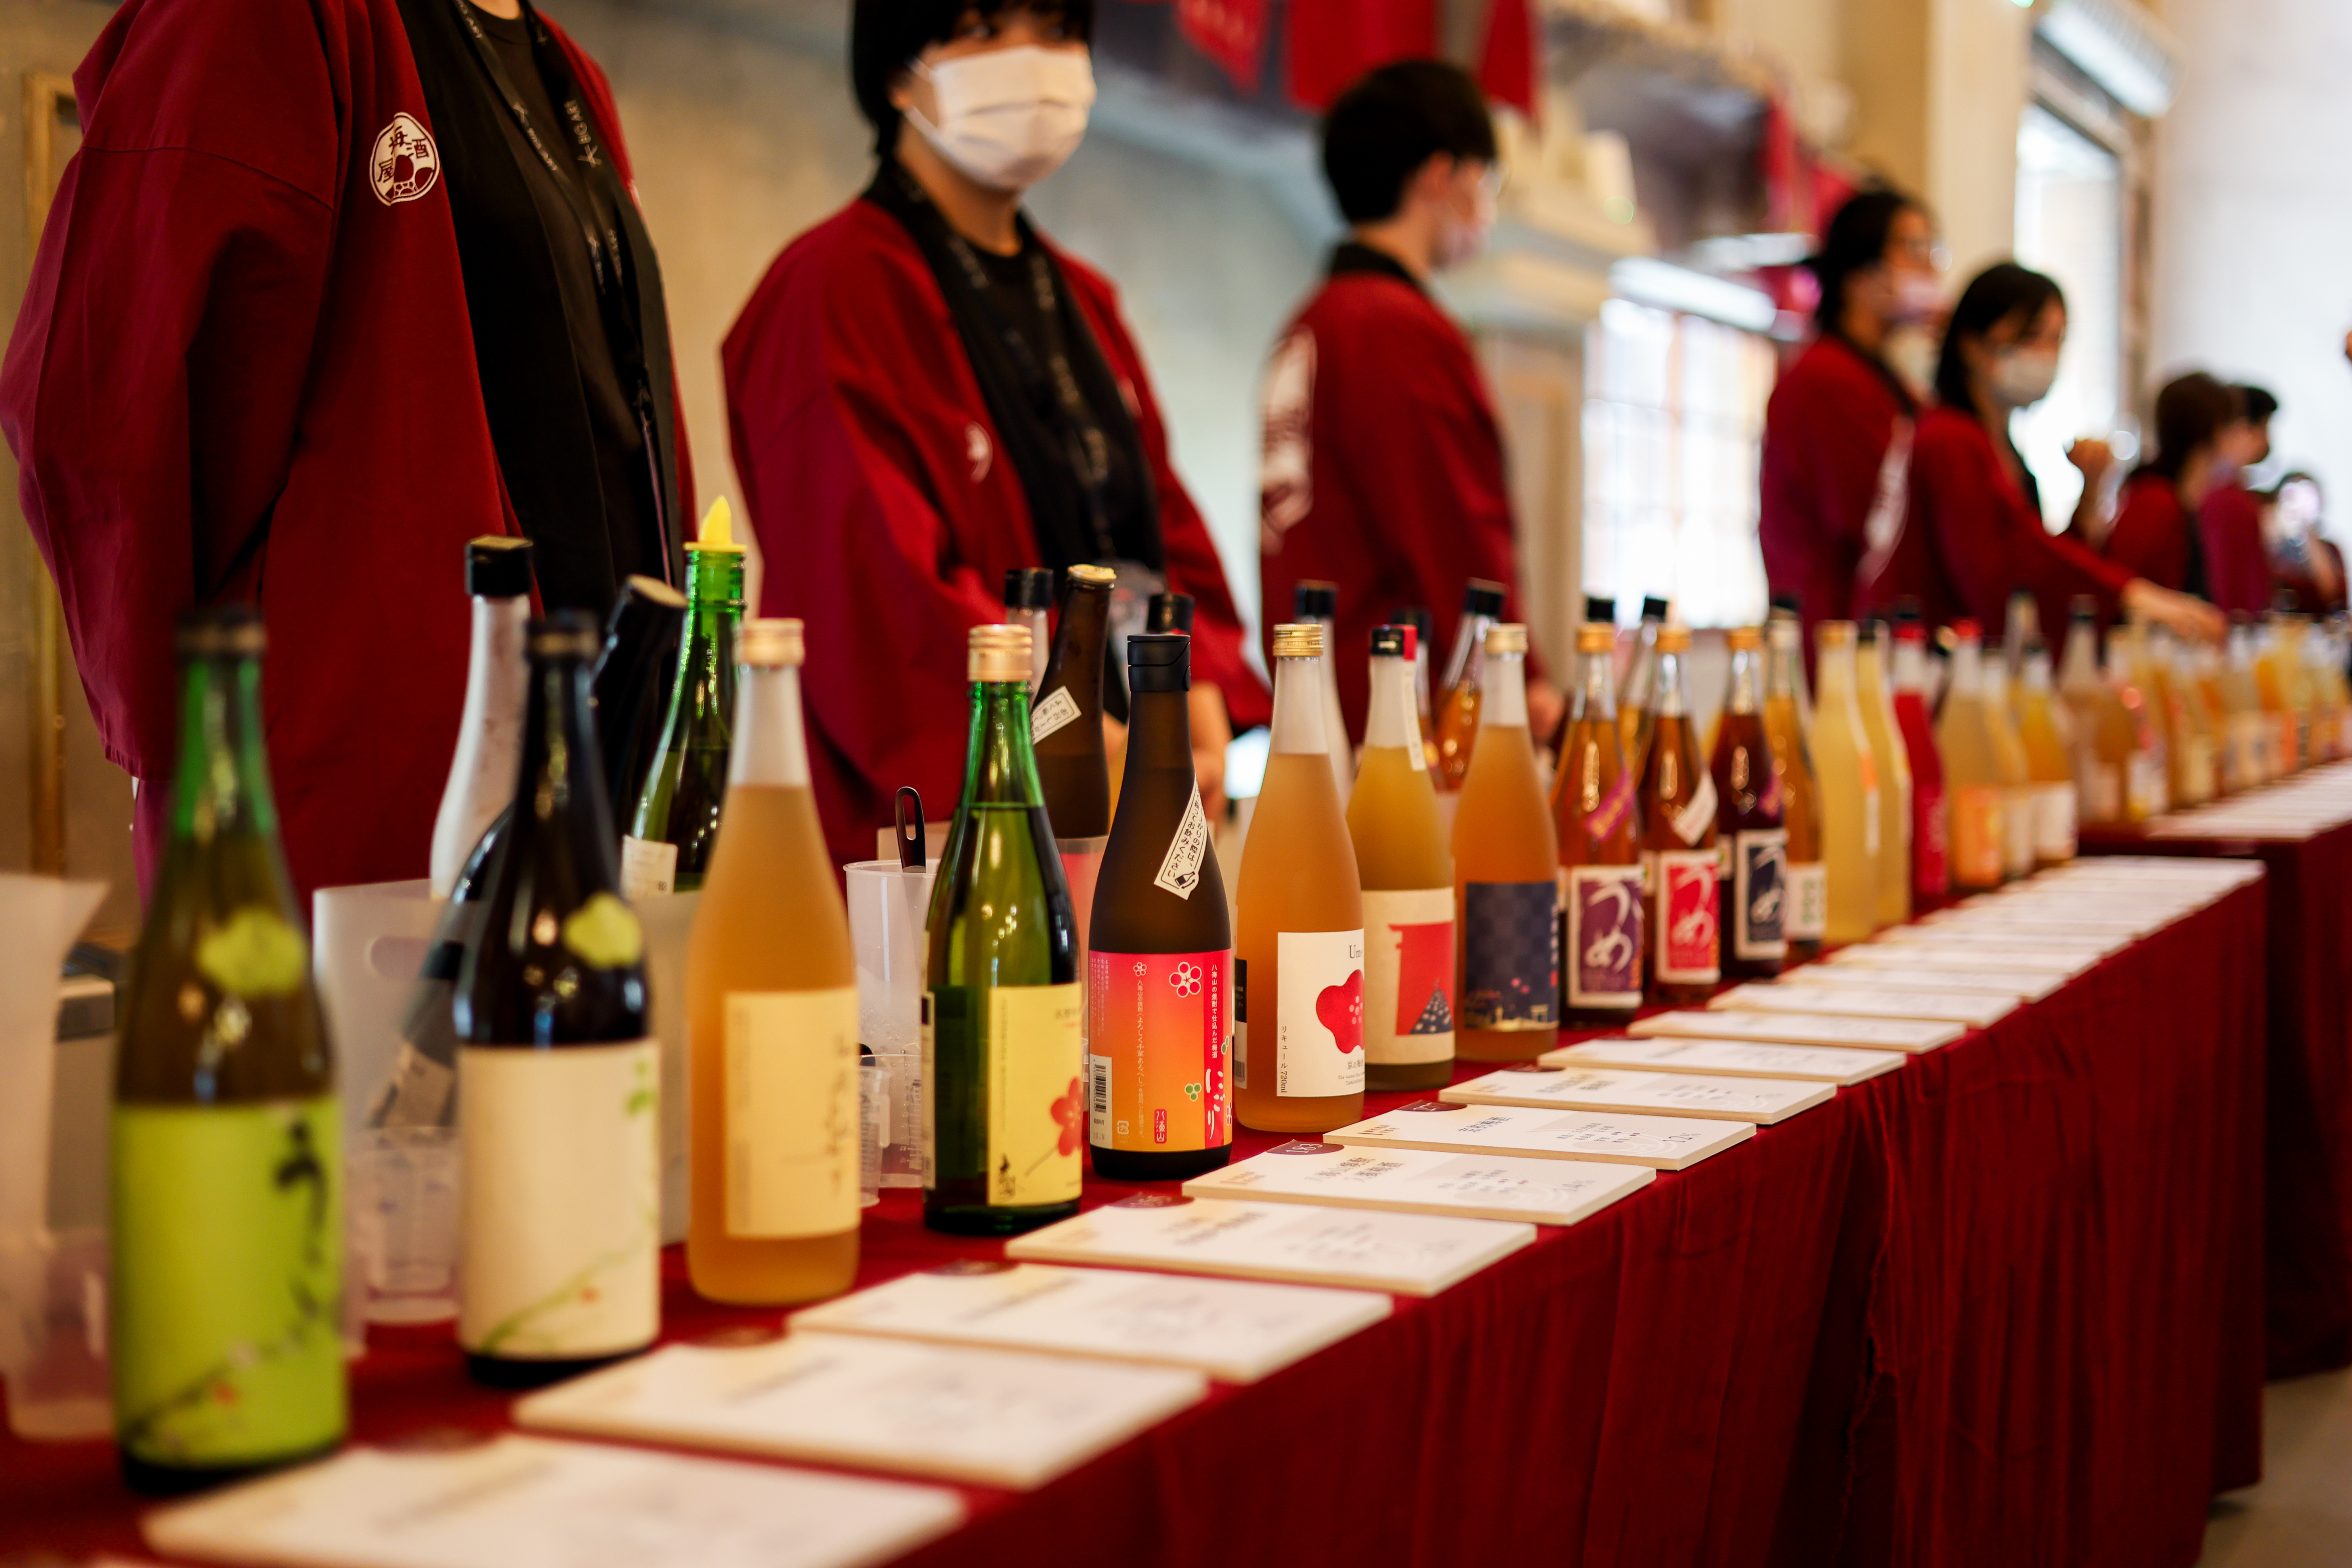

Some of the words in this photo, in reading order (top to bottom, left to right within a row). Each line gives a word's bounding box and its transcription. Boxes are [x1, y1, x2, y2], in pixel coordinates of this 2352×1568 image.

[1206, 1068, 1226, 1140] にごり
[1662, 1133, 1701, 1143] 12%
[1286, 1143, 1323, 1154] 183
